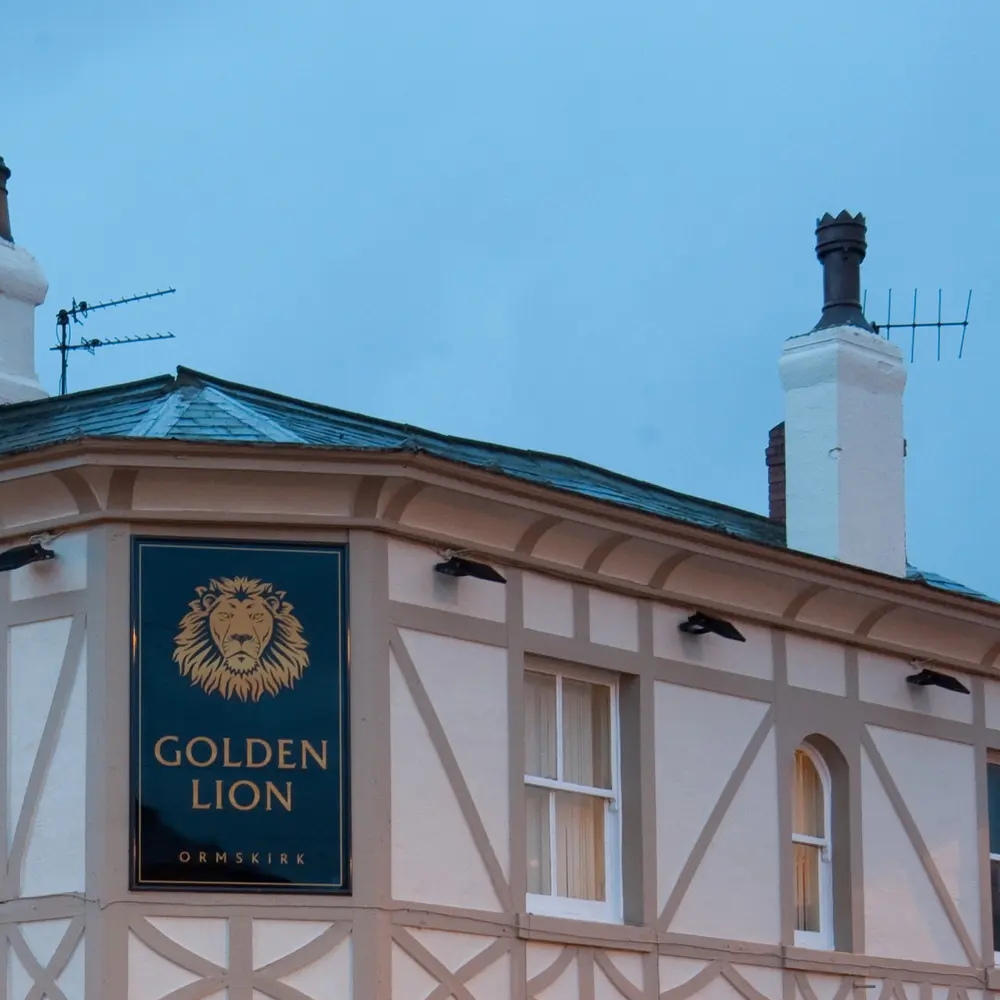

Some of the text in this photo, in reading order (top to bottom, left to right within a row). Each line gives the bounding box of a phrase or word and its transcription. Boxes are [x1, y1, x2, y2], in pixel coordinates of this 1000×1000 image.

[154, 735, 328, 770] GOLDEN
[192, 779, 292, 812] LION
[179, 851, 305, 865] ORMSKIRK
